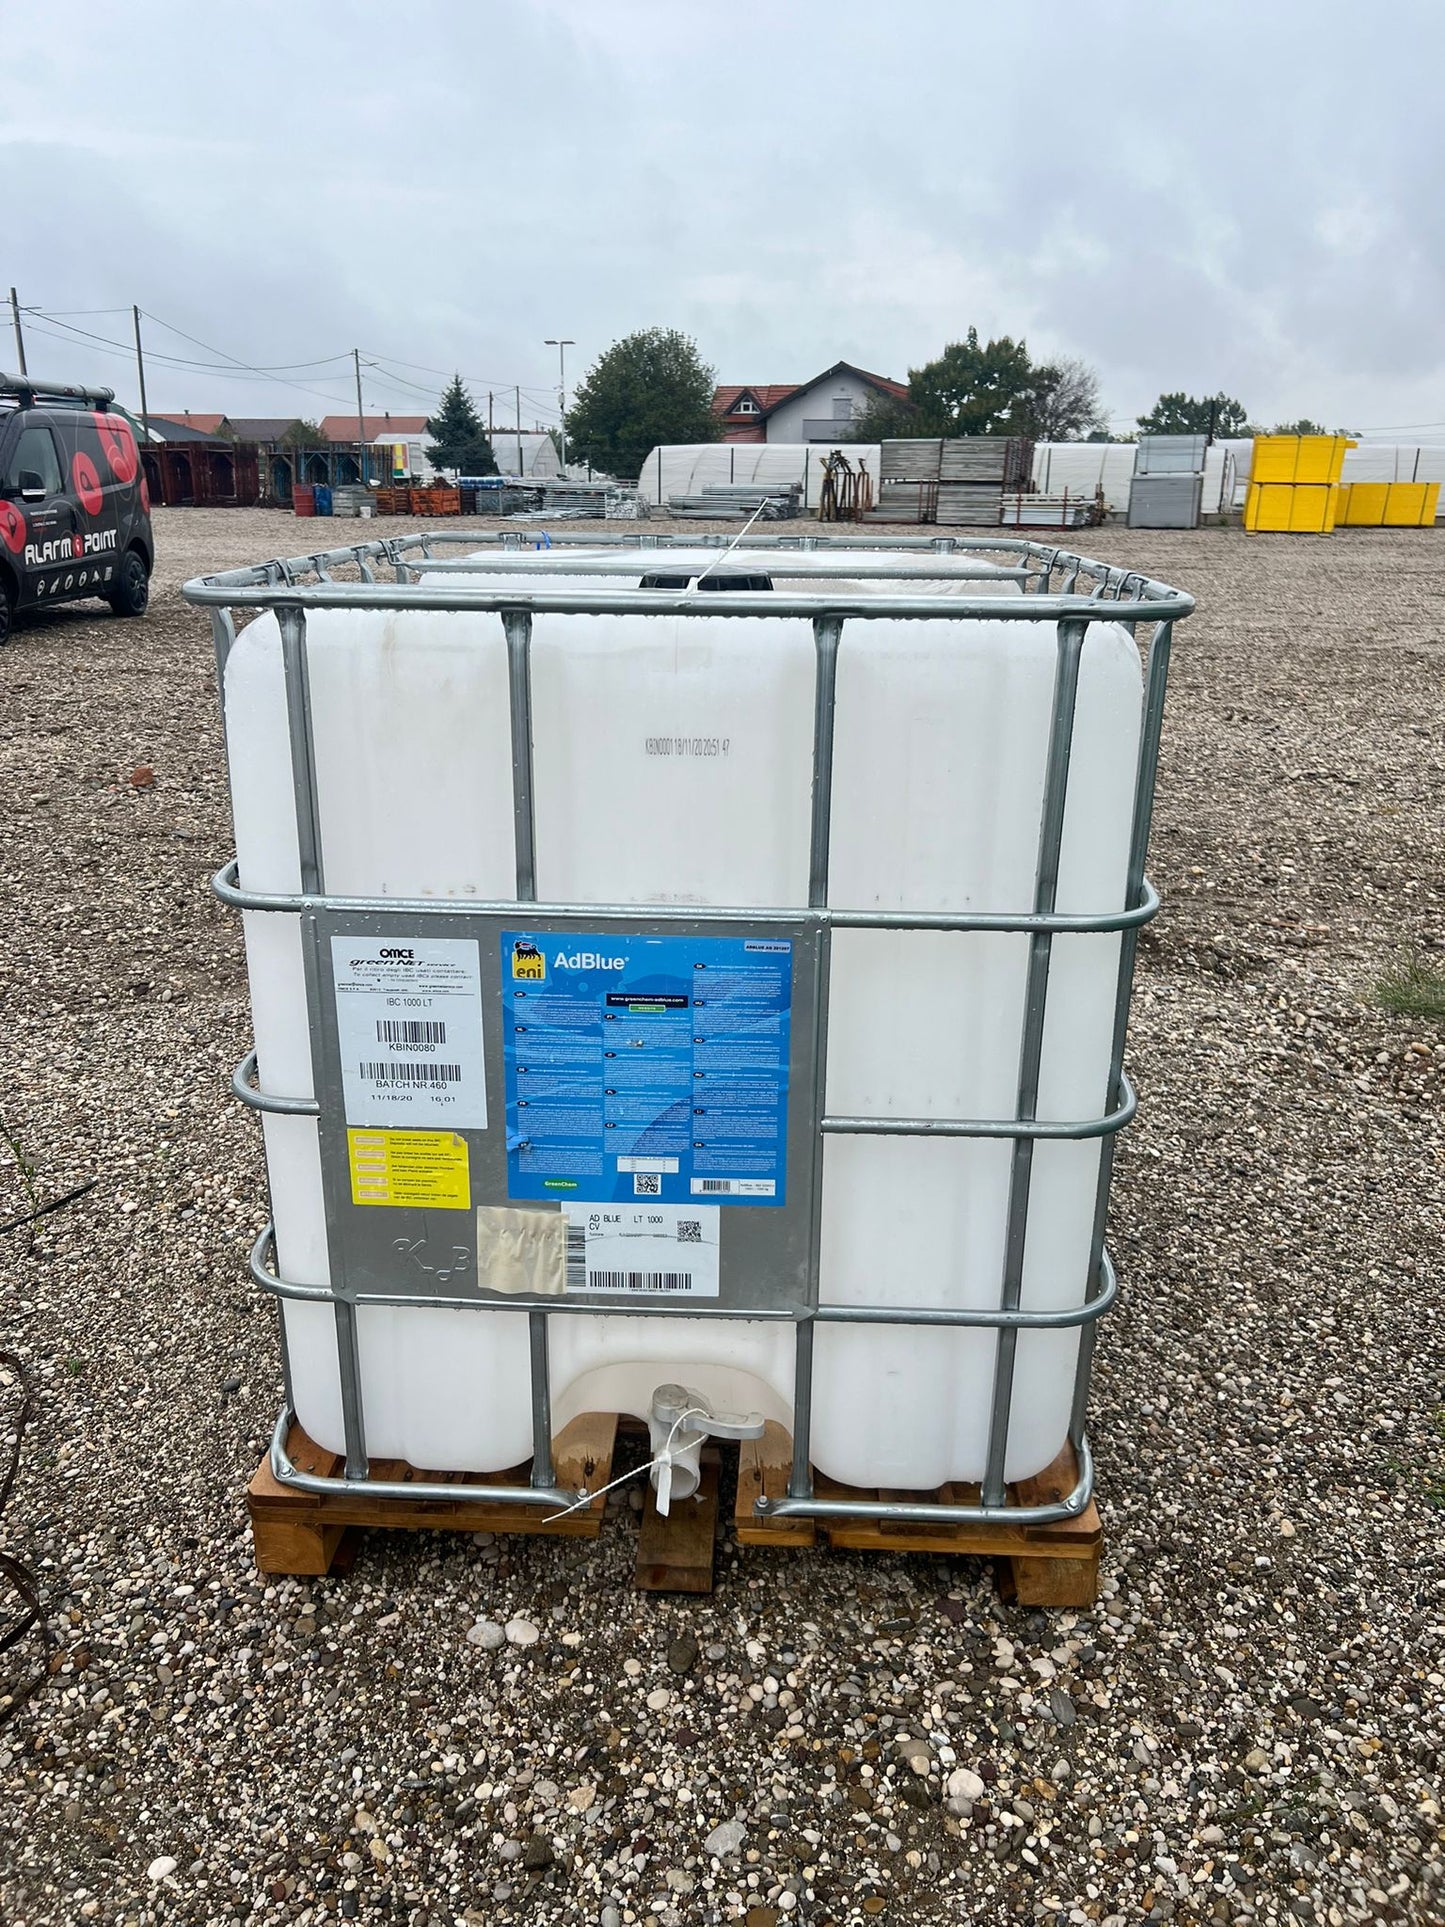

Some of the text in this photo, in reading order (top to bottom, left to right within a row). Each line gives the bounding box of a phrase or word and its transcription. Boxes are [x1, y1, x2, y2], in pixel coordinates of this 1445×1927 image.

[379, 948, 414, 959] OMCE
[516, 964, 542, 979] eni
[386, 998, 434, 1007] IBC 1000 LT
[388, 1043, 436, 1052] KBIN0080
[375, 1080, 410, 1089] BATCH
[370, 1094, 413, 1102] 11/18/20
[589, 1214, 664, 1224] AD BLUE LT 1000
[589, 1222, 600, 1231] CV
